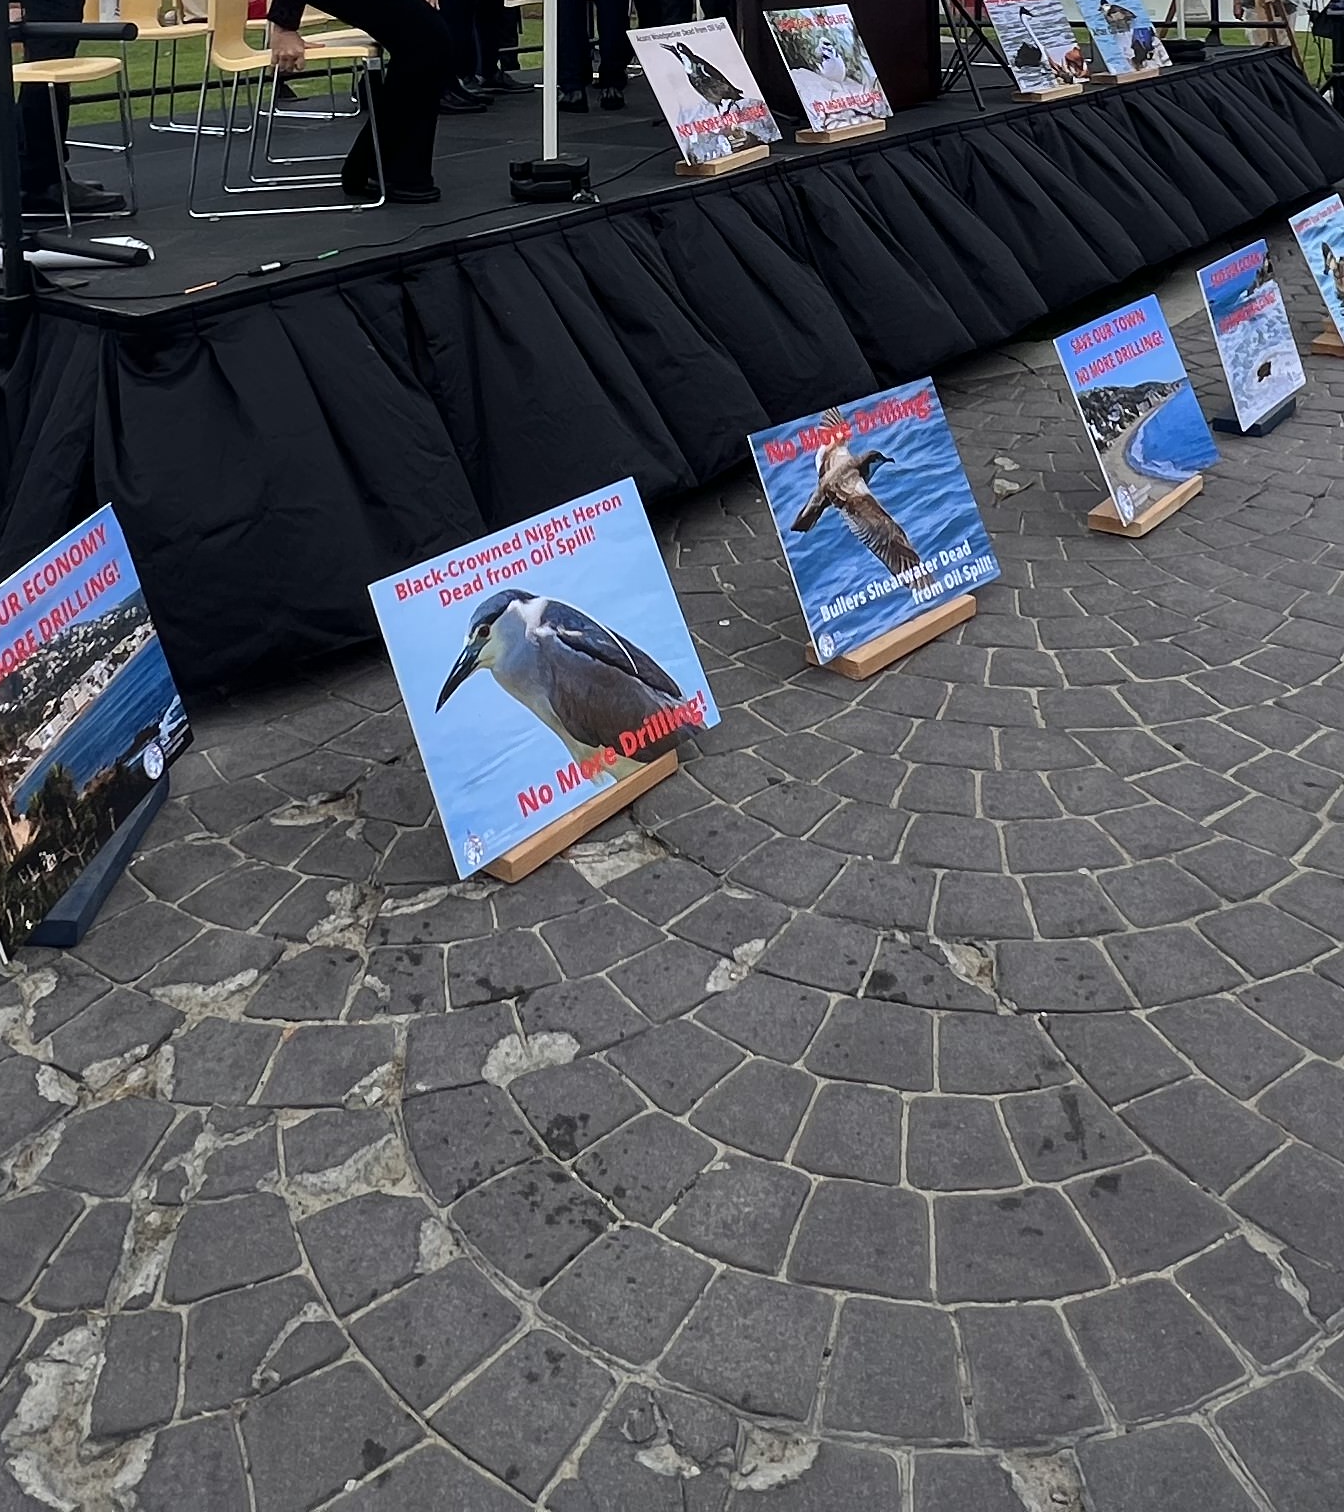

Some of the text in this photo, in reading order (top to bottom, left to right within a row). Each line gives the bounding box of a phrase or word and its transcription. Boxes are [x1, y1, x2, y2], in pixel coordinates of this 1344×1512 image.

[1093, 321, 1115, 343] OUR
[1112, 308, 1146, 333] TOWN
[1074, 366, 1090, 386] NO
[1089, 352, 1117, 379] MORE
[22, 522, 107, 605] ECONOMY
[393, 494, 624, 602] Black-Crowned Night Heron
[439, 524, 597, 608] Dead from Oil Spill!
[819, 539, 972, 622] Bullers Shearwater Dead
[911, 554, 995, 606] from Oil Spill!
[38, 558, 122, 643] DRILLING!
[517, 689, 708, 818] No More Drilling!
